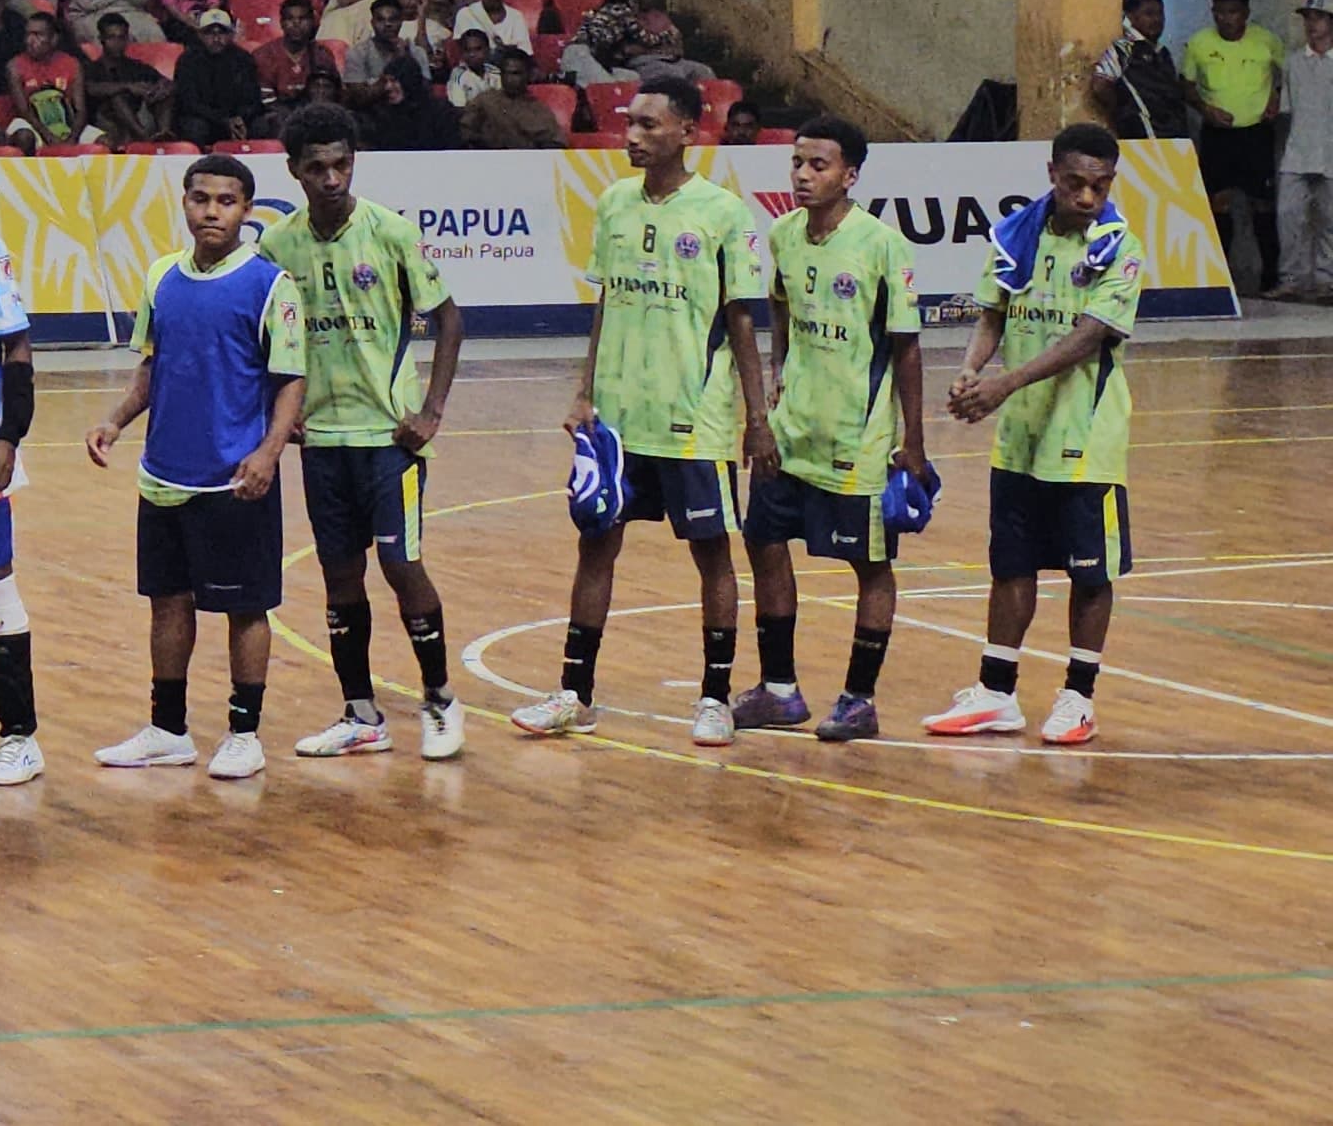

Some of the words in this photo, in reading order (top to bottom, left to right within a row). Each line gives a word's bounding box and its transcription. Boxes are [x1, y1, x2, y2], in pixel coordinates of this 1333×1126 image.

[419, 207, 531, 237] PAPUA
[480, 242, 534, 261] Papua
[643, 223, 657, 254] 8
[322, 262, 338, 291] 6
[805, 265, 818, 294] 9
